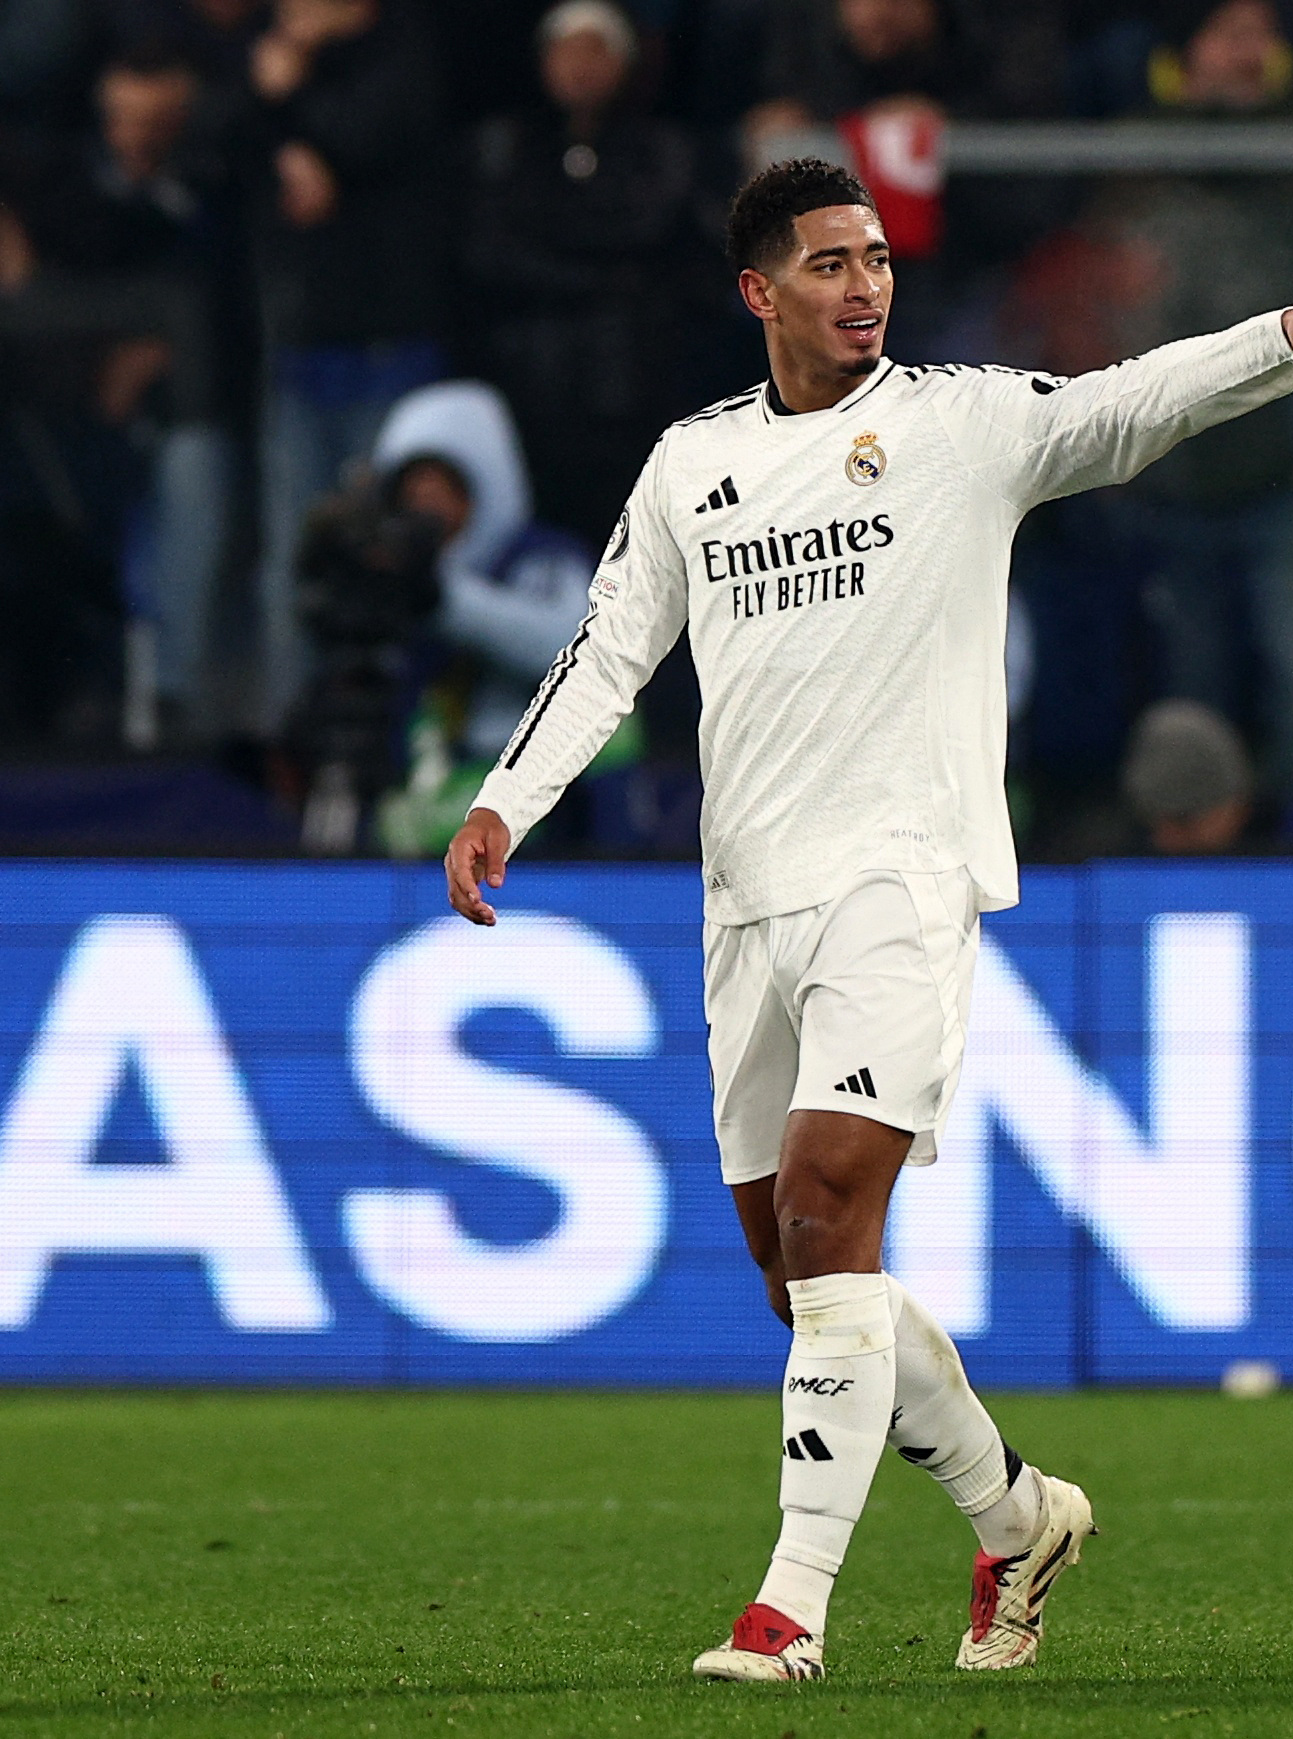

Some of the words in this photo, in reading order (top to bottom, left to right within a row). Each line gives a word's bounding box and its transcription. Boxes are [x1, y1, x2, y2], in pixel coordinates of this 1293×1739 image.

[701, 514, 894, 582] Emirates
[732, 581, 766, 620] FLY
[777, 562, 864, 611] BETTER
[0, 910, 670, 1343] AS
